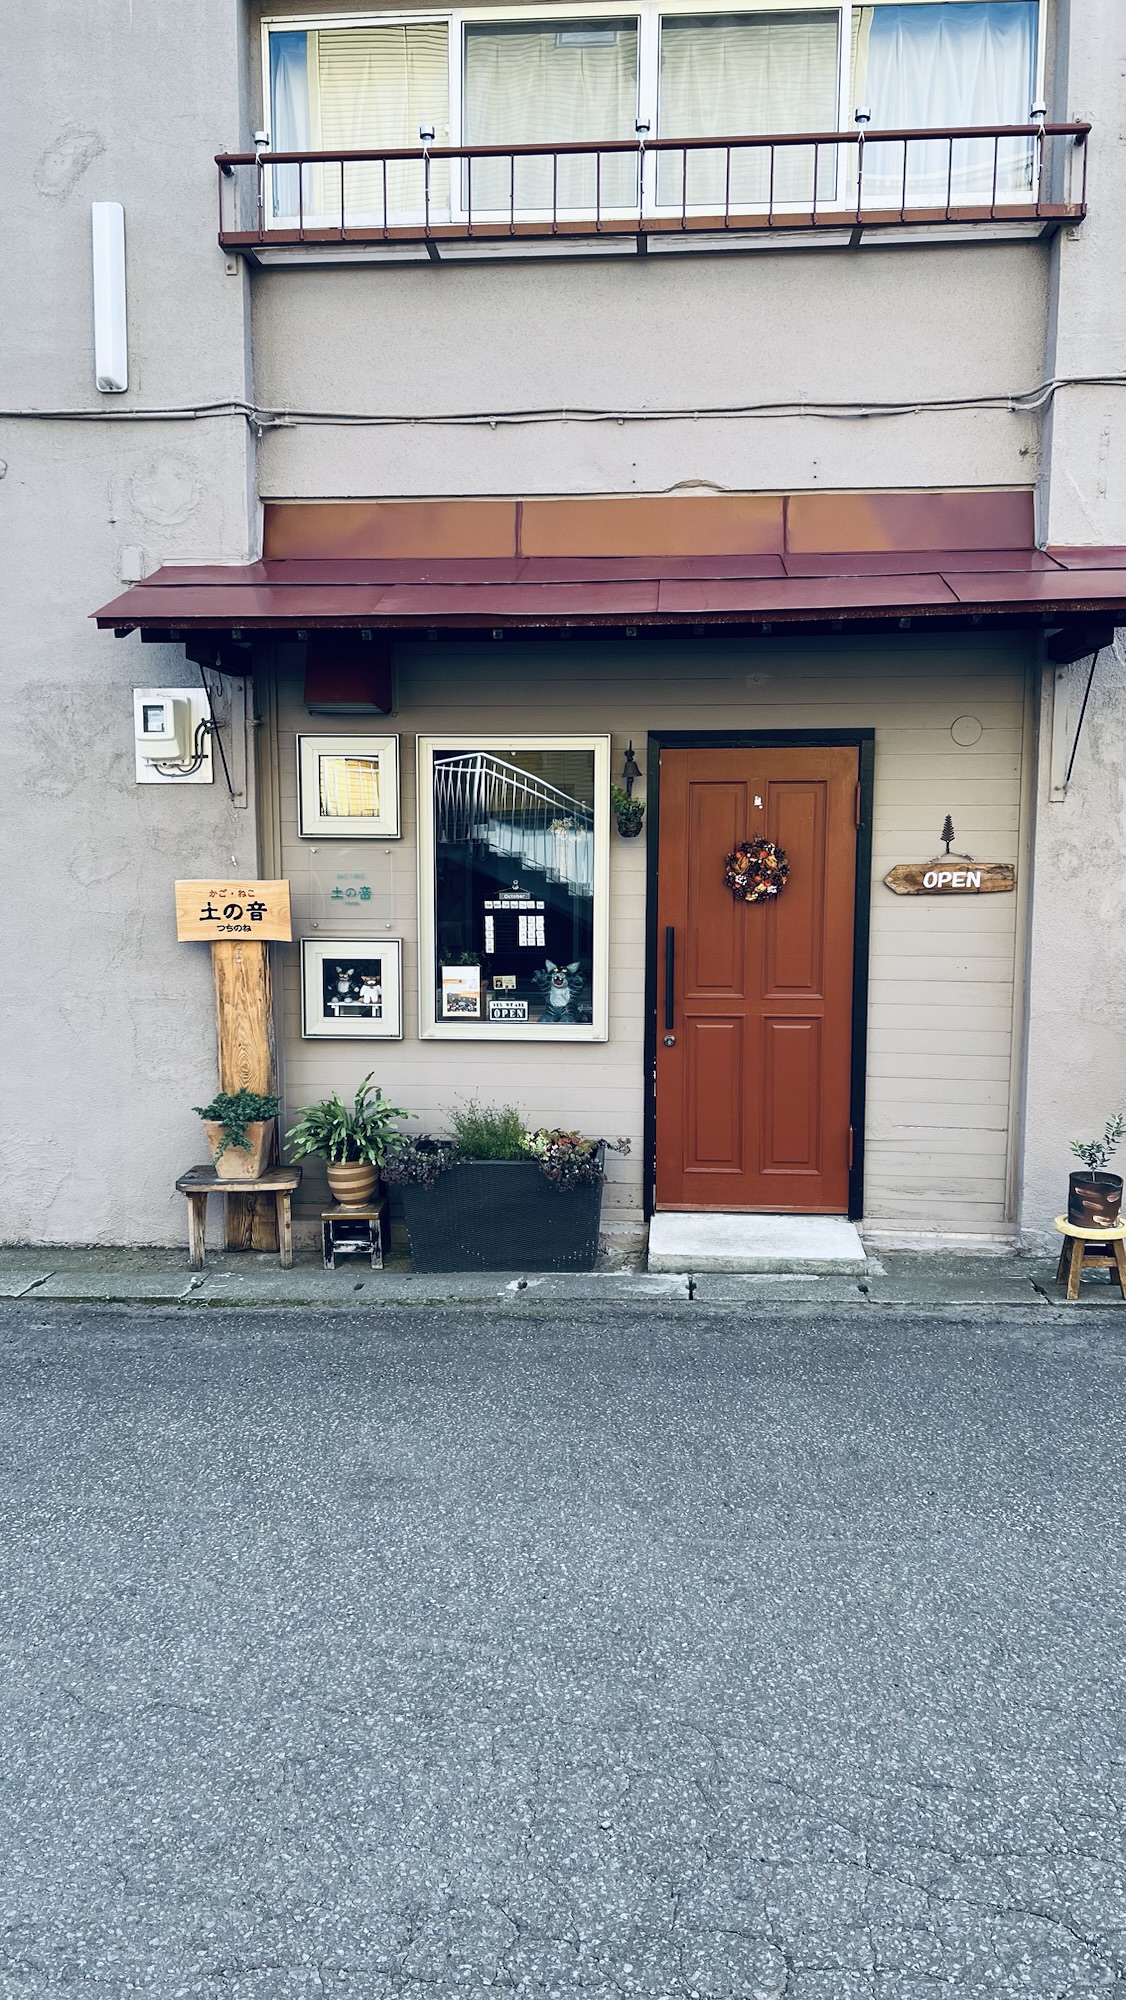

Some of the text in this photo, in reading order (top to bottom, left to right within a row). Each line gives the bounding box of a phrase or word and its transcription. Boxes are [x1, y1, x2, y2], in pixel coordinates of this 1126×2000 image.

[923, 871, 981, 888] OPEN
[209, 889, 255, 898] かご・ねこ
[331, 886, 372, 900] 土の音
[199, 901, 268, 921] 土の音
[216, 924, 252, 932] つちのね
[493, 1008, 524, 1018] OPEN
